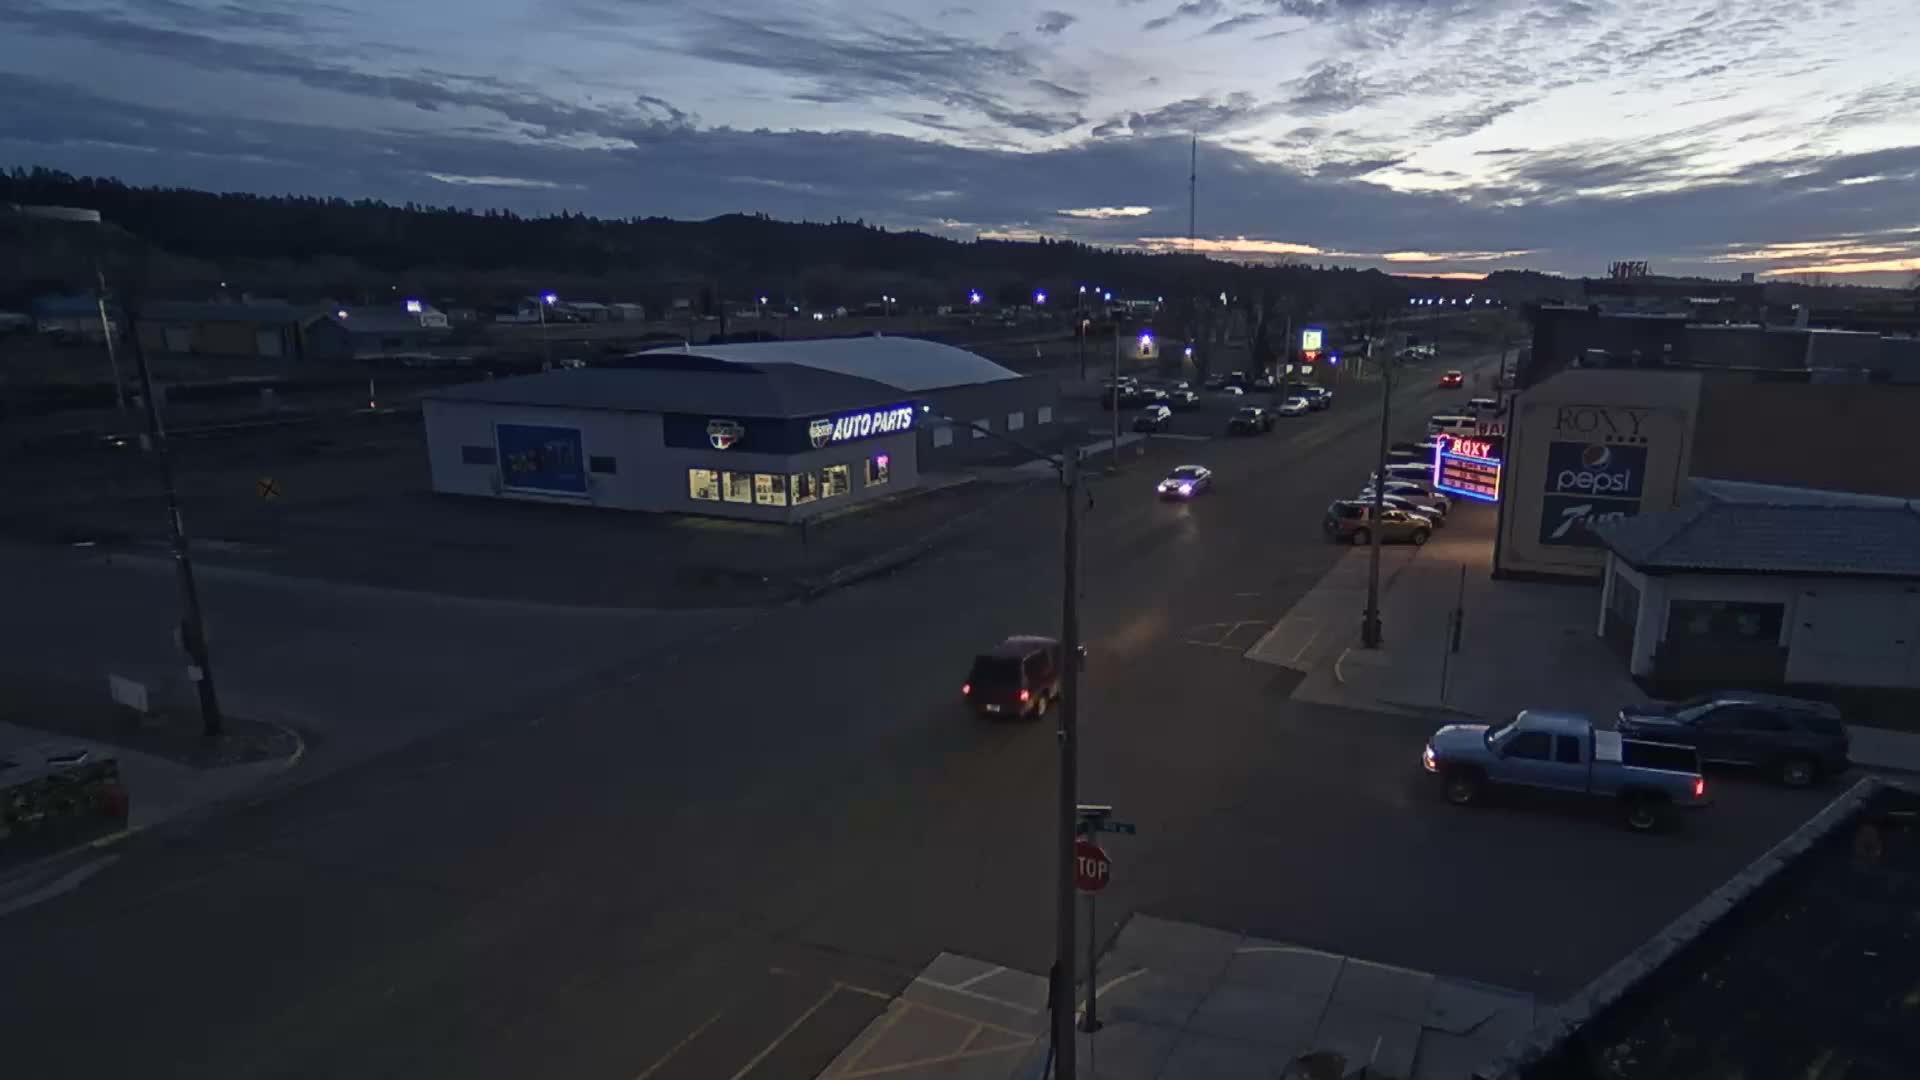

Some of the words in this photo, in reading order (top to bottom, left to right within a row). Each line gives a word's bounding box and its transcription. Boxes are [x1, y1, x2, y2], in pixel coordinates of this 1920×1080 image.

[832, 414, 871, 440] AUTO
[871, 407, 912, 434] PARTS
[1479, 423, 1504, 434] BA
[1553, 407, 1648, 434] ROXY
[1453, 440, 1490, 459] ROXY
[1556, 469, 1631, 494] pepsi
[1078, 856, 1107, 880] TOP
